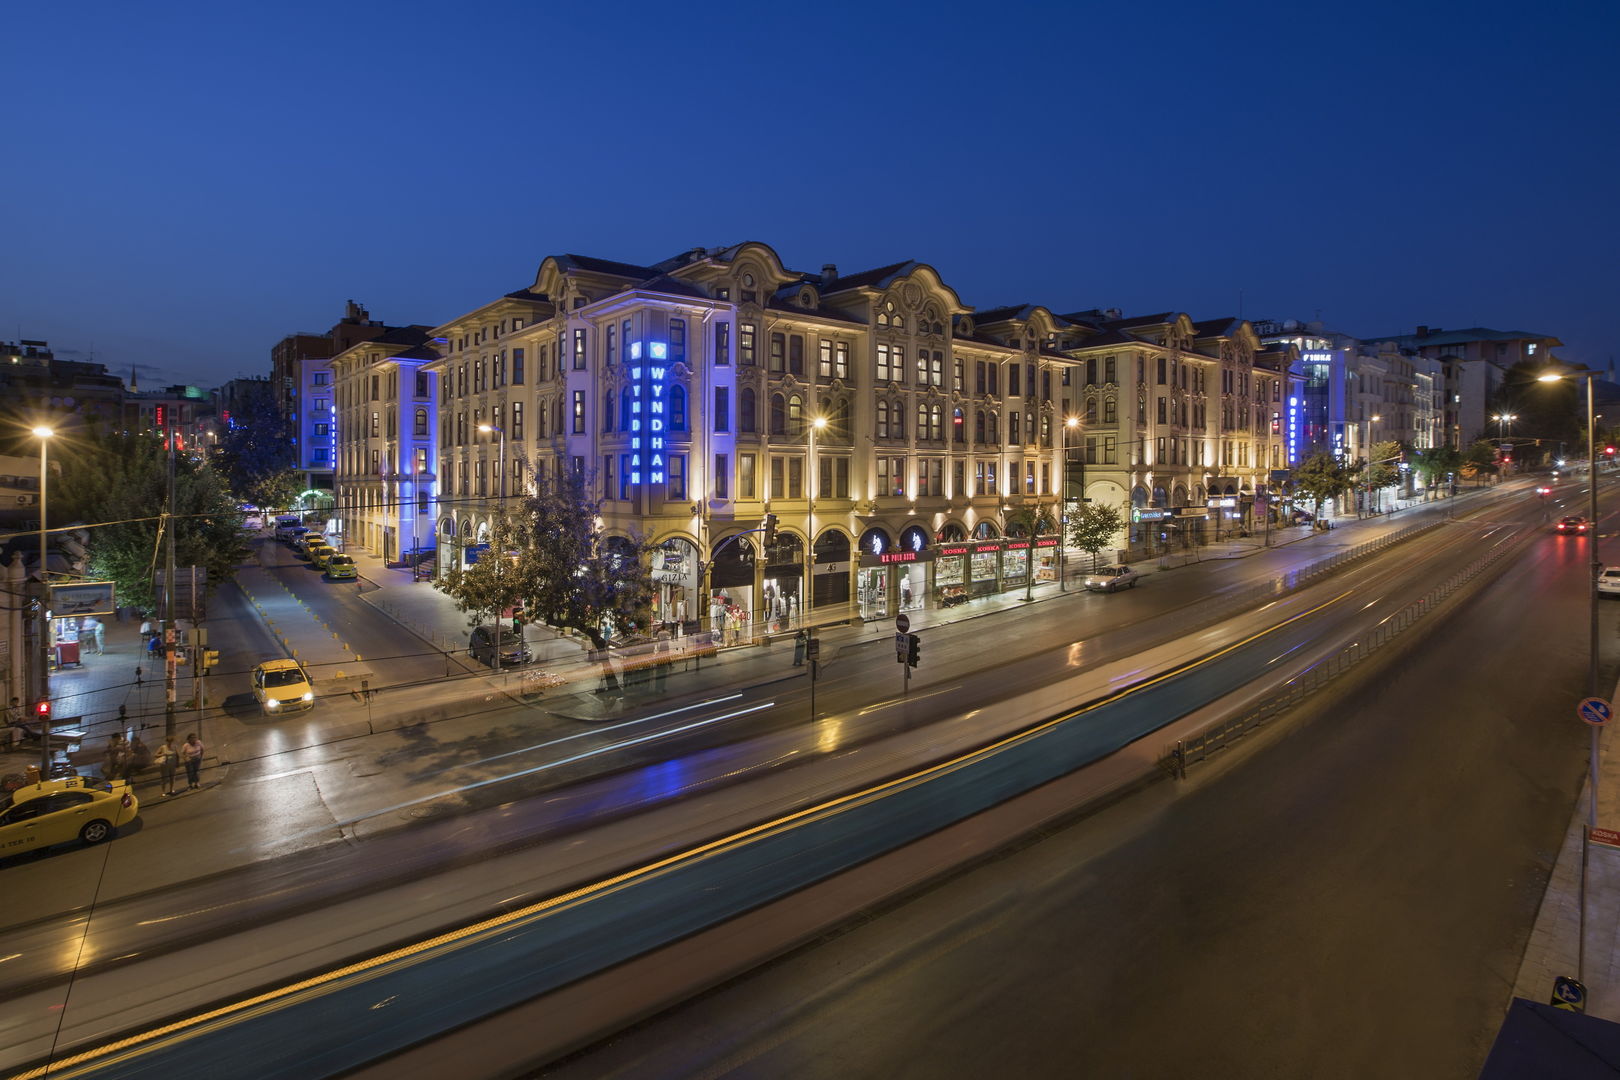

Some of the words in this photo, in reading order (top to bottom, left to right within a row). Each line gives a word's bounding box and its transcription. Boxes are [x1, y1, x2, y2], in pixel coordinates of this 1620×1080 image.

[631, 367, 641, 484] WYNDHAM
[651, 367, 665, 484] WYNDHAM
[661, 573, 688, 581] GIZIA
